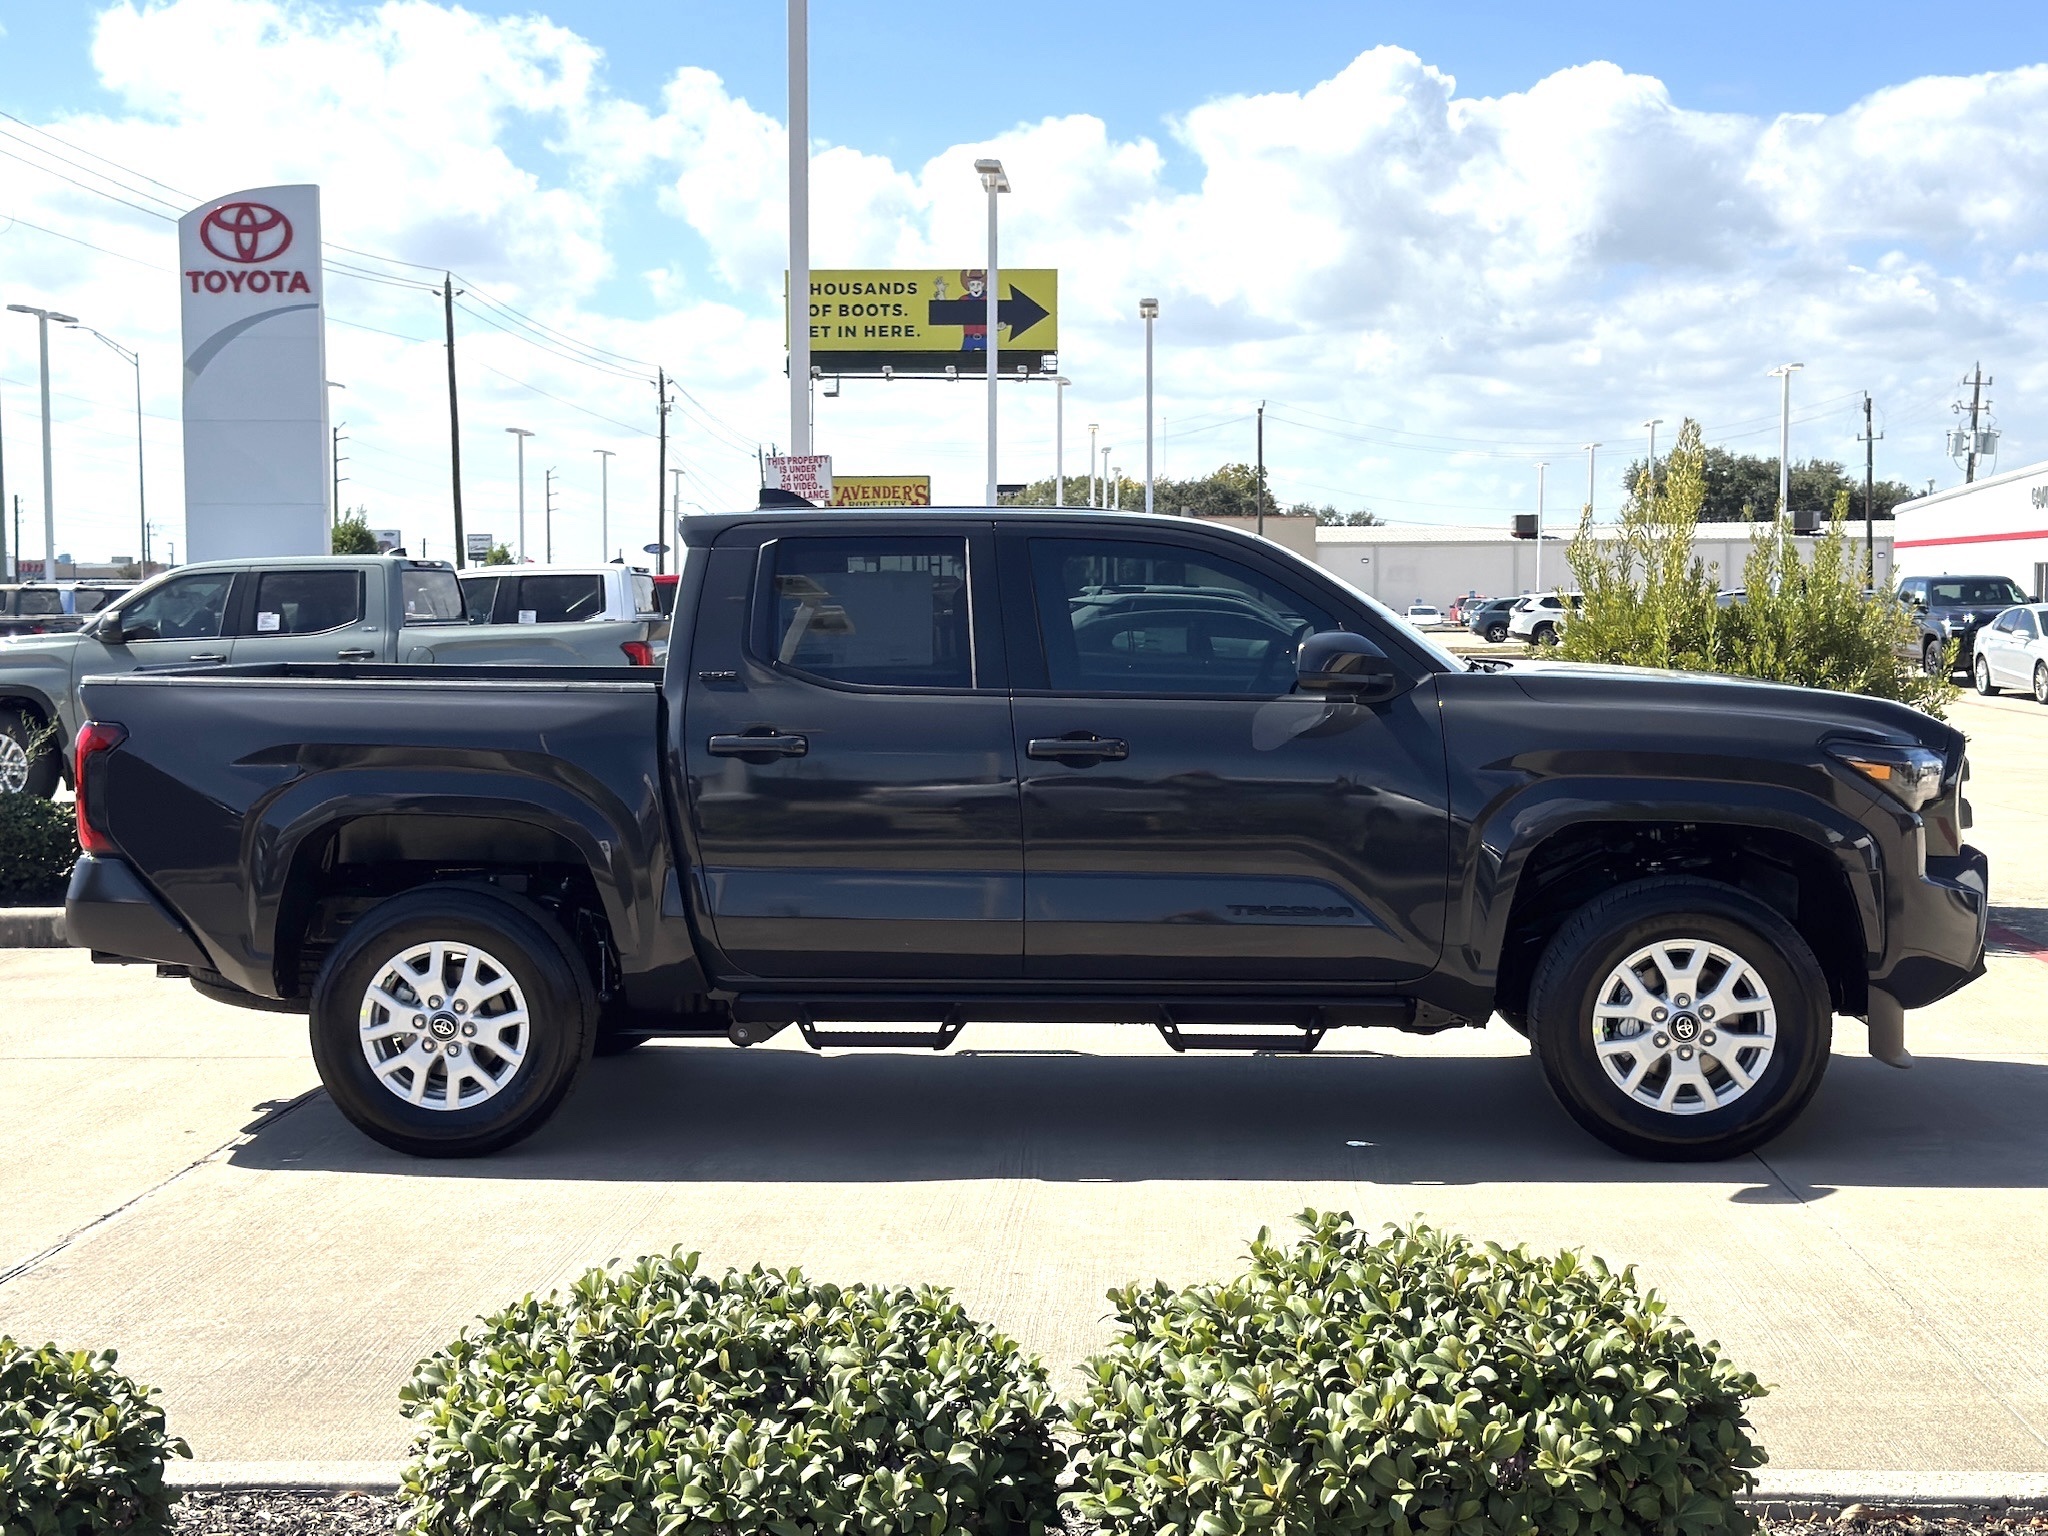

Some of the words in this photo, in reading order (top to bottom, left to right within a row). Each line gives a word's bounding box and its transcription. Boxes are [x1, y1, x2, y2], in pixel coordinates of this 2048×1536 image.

[185, 270, 311, 294] TOYOTA
[810, 282, 918, 296] HOUSANDS
[809, 304, 832, 317] OF
[839, 303, 908, 317] BOOTS.
[809, 325, 831, 338] ET
[838, 326, 857, 338] IN
[864, 325, 920, 338] HERE.
[767, 457, 786, 466] THIS
[787, 455, 829, 465] PROPERTY
[780, 465, 788, 474] IS
[789, 464, 817, 474] UNDER
[781, 474, 791, 483] 24
[793, 473, 816, 482] HOUR
[780, 483, 792, 491] HD
[793, 482, 818, 491] VIDEO
